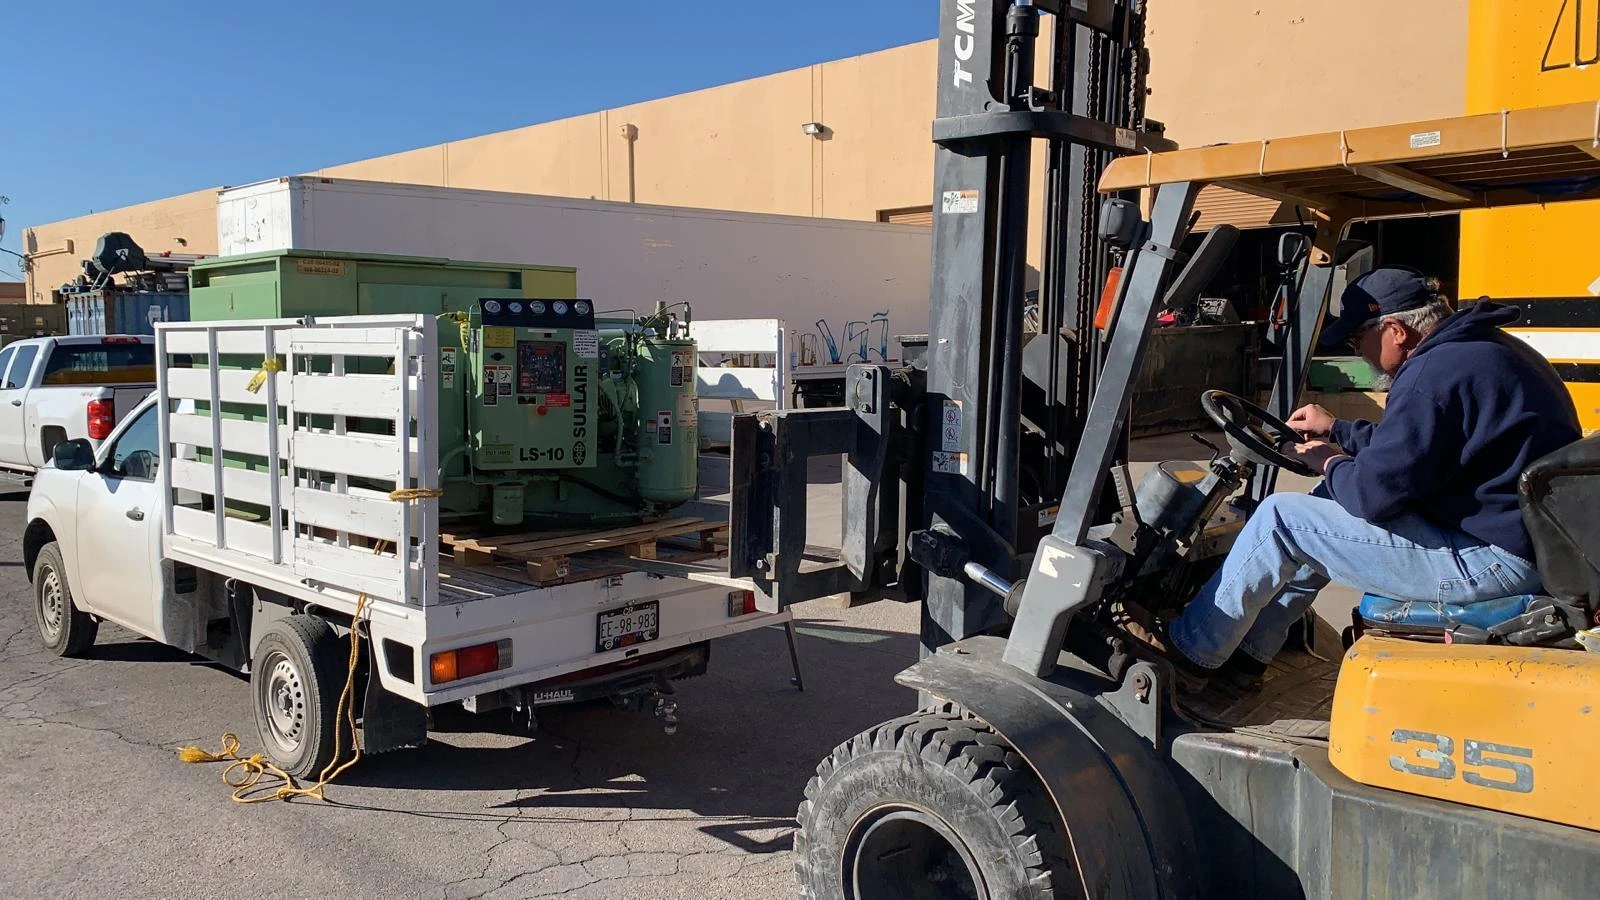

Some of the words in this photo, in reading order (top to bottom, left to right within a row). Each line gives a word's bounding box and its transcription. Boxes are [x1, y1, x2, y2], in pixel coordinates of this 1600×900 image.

[954, 0, 975, 89] TCM
[573, 366, 587, 438] SULLAIR
[519, 447, 565, 461] LS-10
[601, 612, 656, 639] EE-98-983
[1389, 729, 1534, 793] 35
